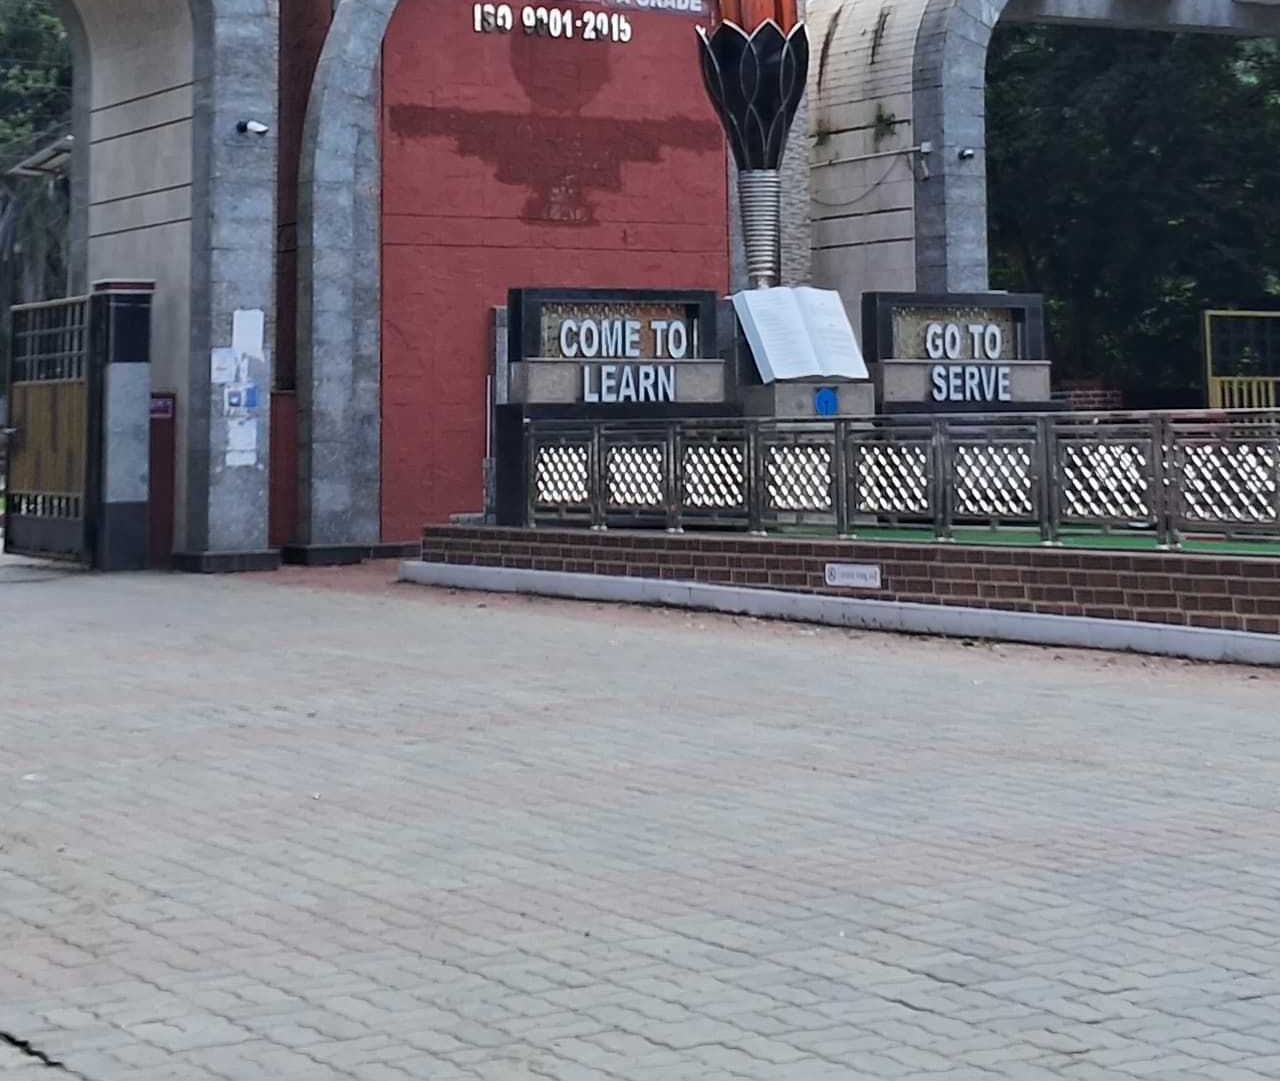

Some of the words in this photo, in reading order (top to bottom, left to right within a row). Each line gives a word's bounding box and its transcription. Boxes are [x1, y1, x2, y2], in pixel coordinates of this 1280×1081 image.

[473, 3, 513, 33] ISO
[559, 318, 642, 358] COME
[650, 319, 688, 359] TO
[926, 322, 961, 360] GO
[967, 323, 1002, 360] TO
[583, 364, 676, 403] LEARN
[931, 364, 1012, 402] SERVE
